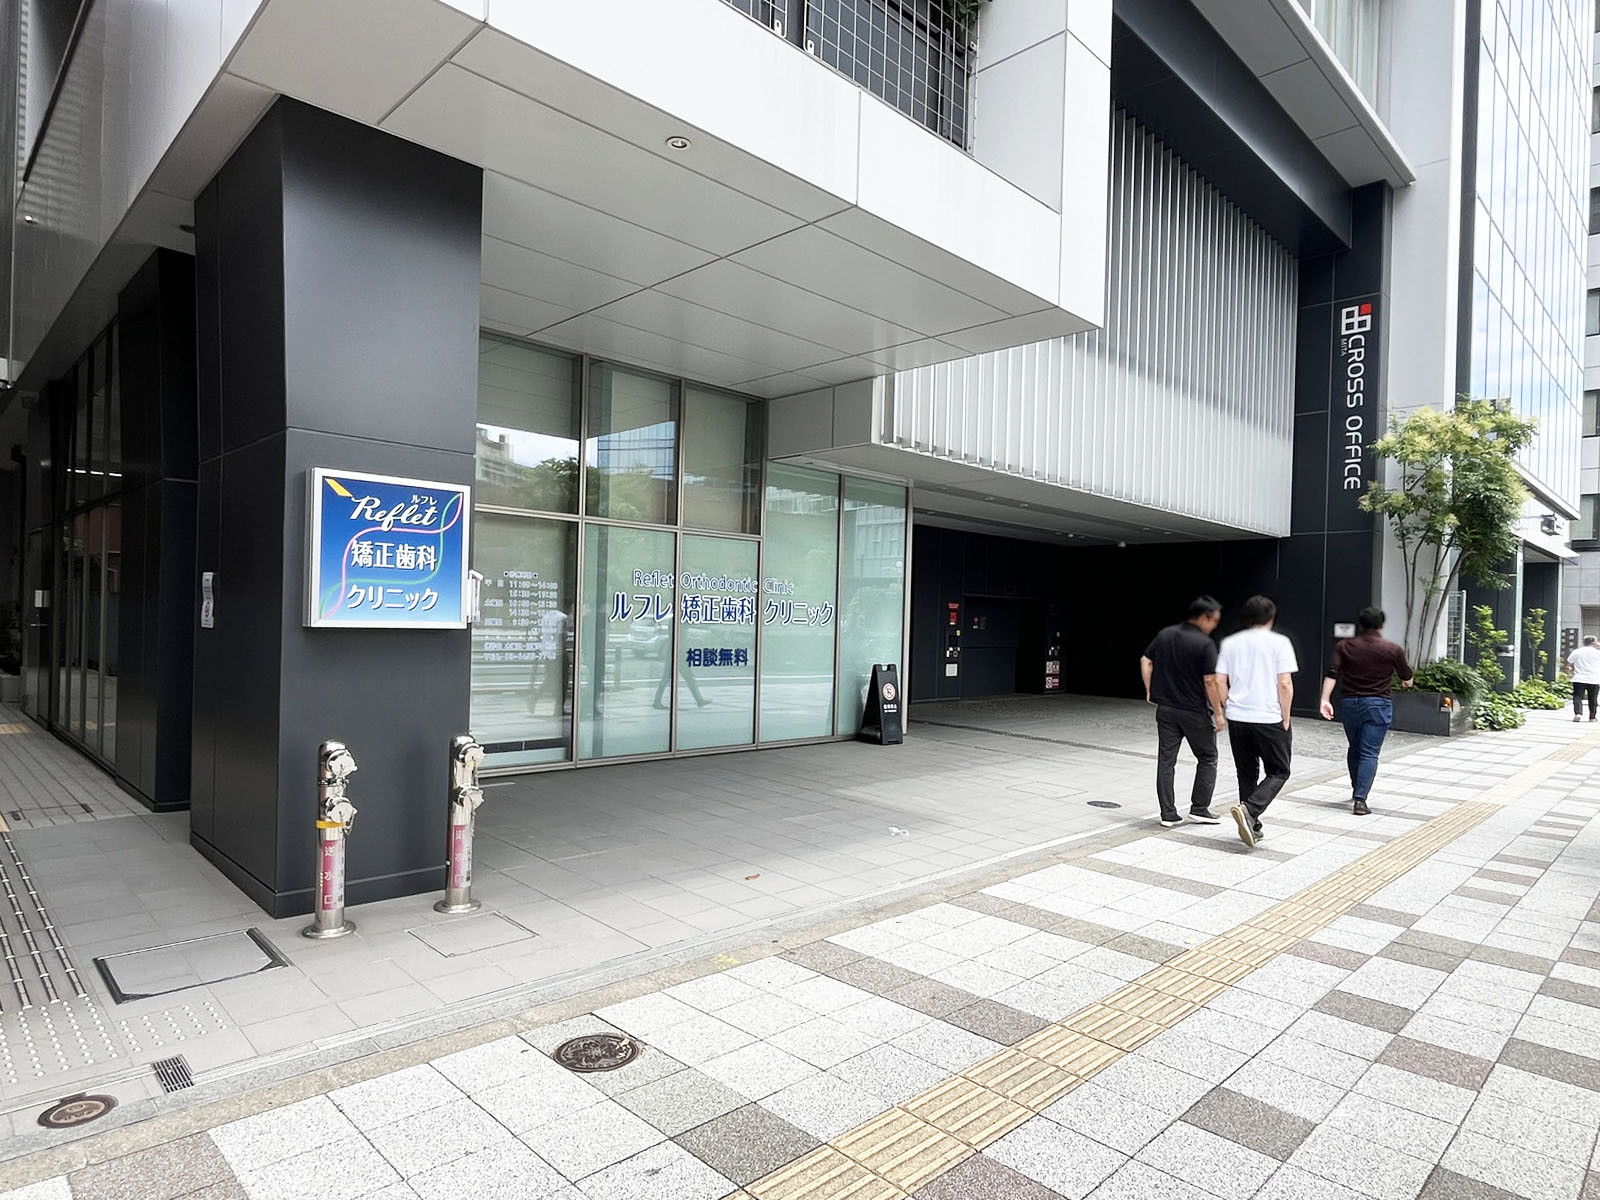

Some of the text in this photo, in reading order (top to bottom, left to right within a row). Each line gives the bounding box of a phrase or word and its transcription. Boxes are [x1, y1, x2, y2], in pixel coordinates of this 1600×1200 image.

[1343, 334, 1365, 490] CROSS OFFICE
[350, 495, 438, 532] Reflet
[410, 494, 438, 505] ルフレ
[350, 540, 437, 571] 矯正歯科
[633, 569, 795, 595] Reflet Orthodontic Clinic
[347, 584, 438, 611] クリニック
[609, 592, 834, 626] ルフレ 矯正歯科 クリニック
[686, 648, 748, 667] 相談無料
